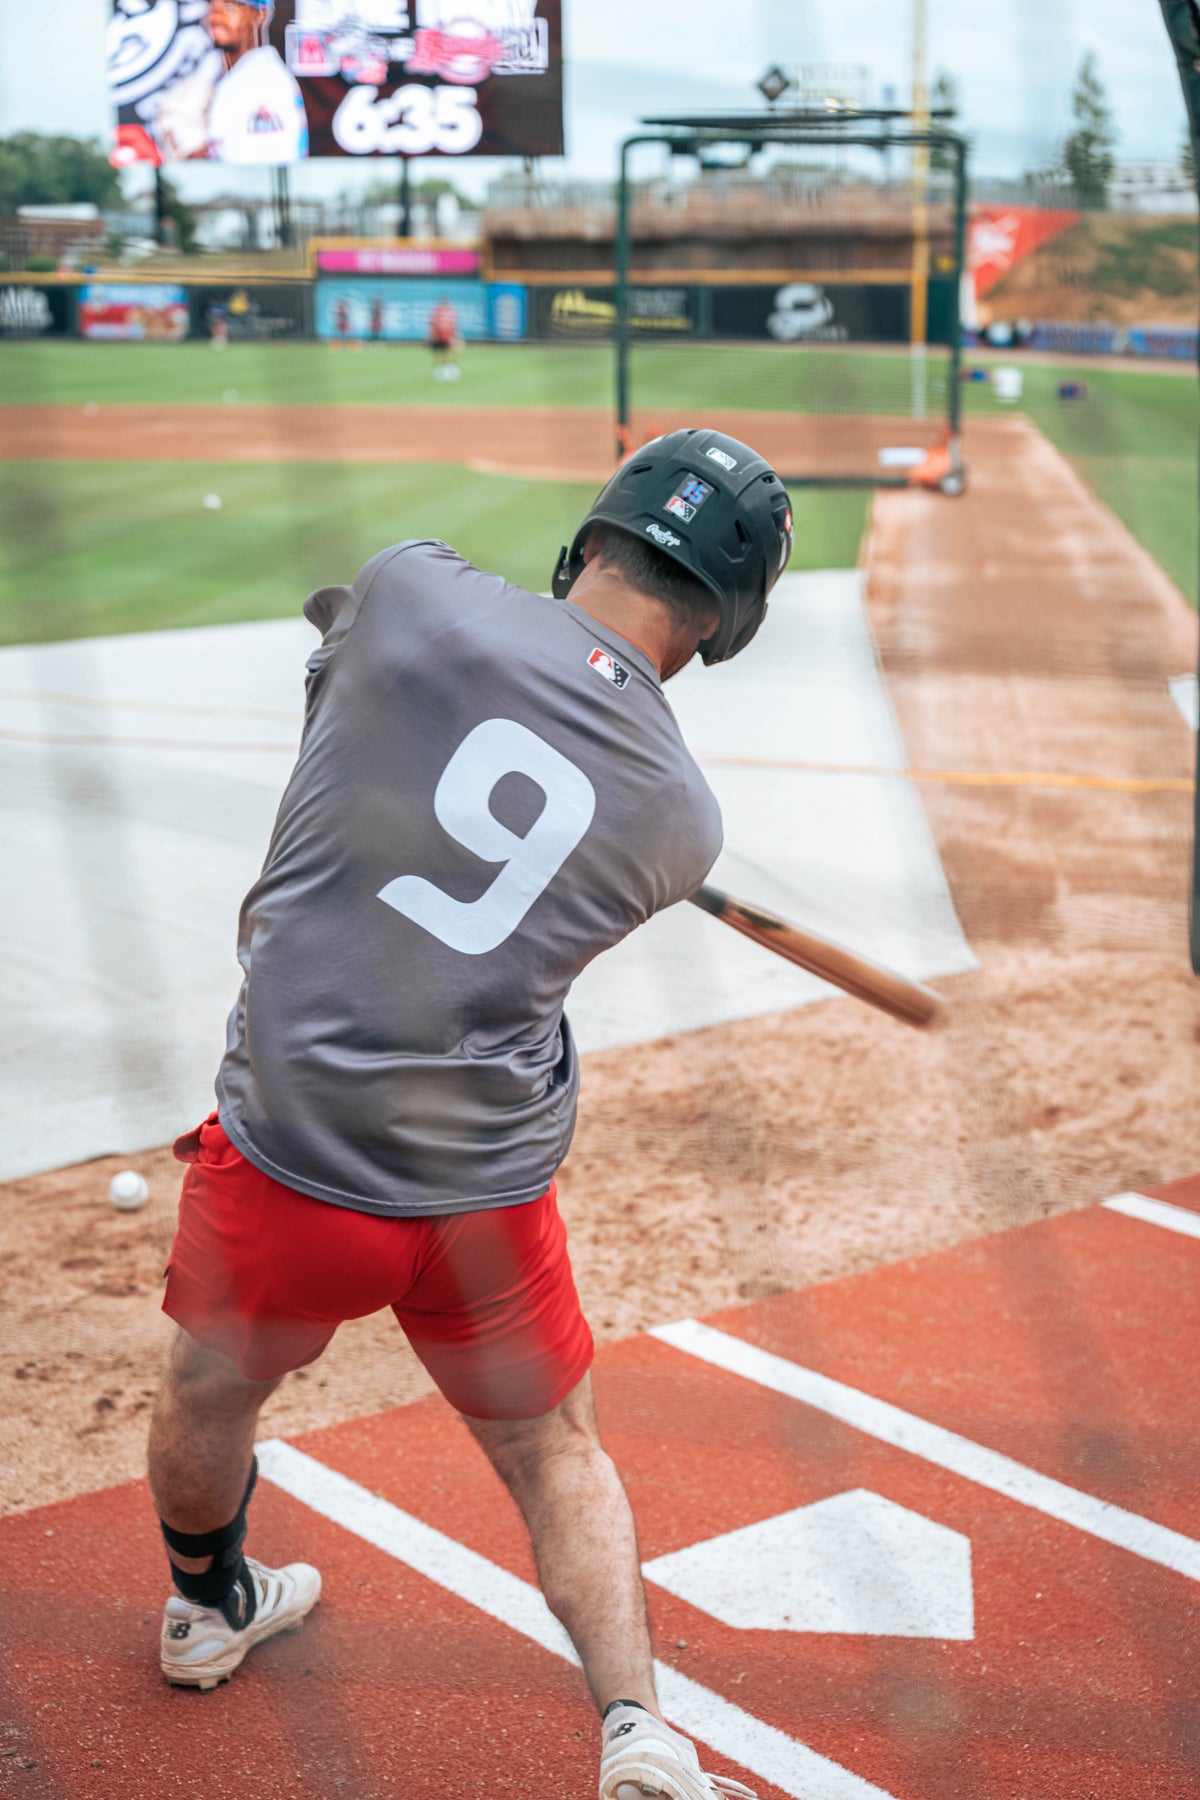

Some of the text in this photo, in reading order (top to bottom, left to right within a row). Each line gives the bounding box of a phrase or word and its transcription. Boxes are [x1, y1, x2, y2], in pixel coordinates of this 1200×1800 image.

[332, 83, 483, 155] 6:35
[681, 480, 709, 505] 15
[376, 718, 596, 955] 9
